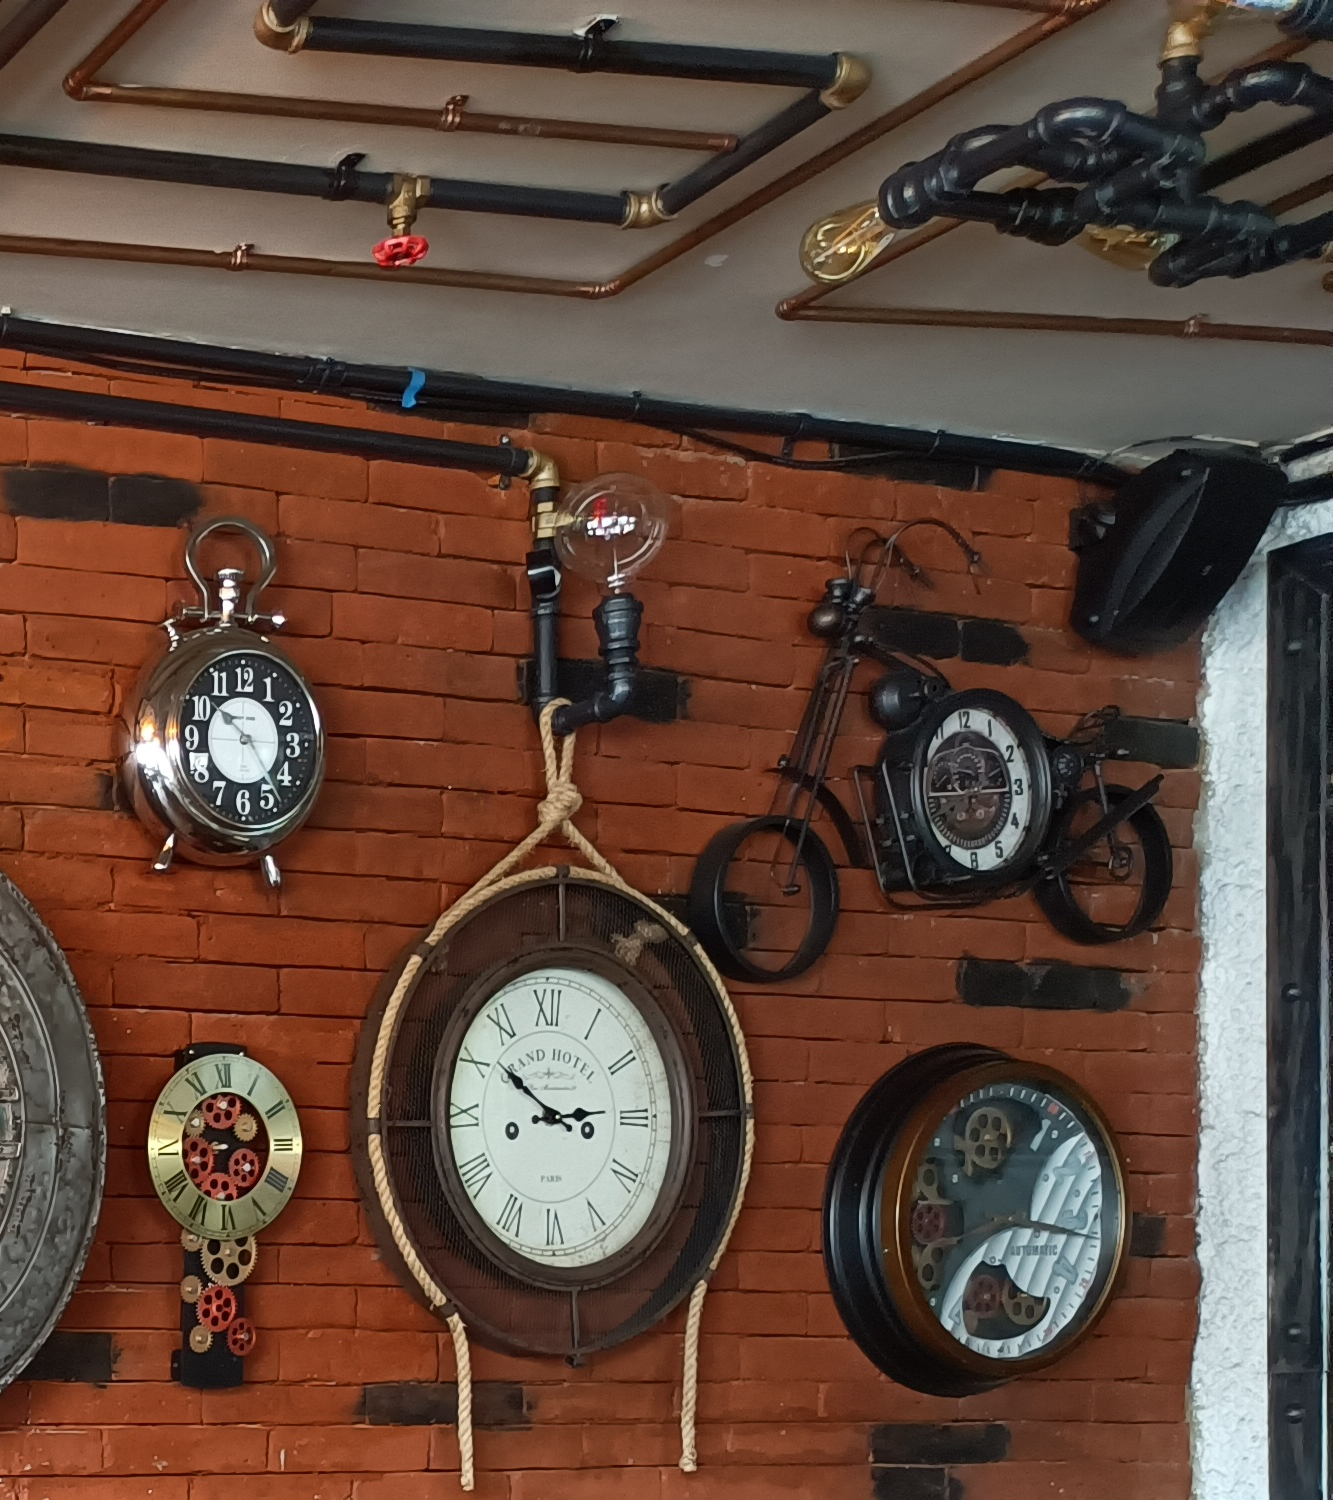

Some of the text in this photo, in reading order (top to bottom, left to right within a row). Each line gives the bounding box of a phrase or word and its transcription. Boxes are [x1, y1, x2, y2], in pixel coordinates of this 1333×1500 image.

[211, 671, 229, 697] 11
[235, 667, 254, 692] 12
[263, 677, 275, 702] 1
[192, 695, 211, 721] 10
[279, 701, 293, 726] 2
[958, 711, 971, 730] 12
[185, 725, 199, 750] 9
[987, 719, 992, 737] 1
[286, 732, 300, 757] 3
[1005, 745, 1014, 763] 2
[194, 756, 209, 783] 8
[277, 761, 292, 786] 4
[212, 780, 226, 806] 7
[260, 784, 275, 809] 5
[1013, 778, 1024, 796] 3
[236, 789, 251, 815] 6
[1010, 812, 1019, 829] 4
[994, 840, 1004, 859] 5
[533, 989, 561, 1027] XII
[486, 1003, 516, 1046] XI
[584, 1008, 601, 1040] I
[459, 1046, 490, 1078] X
[551, 1048, 595, 1084] HOTEL
[608, 1049, 636, 1075] II
[185, 1071, 207, 1098] XI
[214, 1063, 232, 1089] XII
[247, 1073, 260, 1097] I
[163, 1101, 188, 1122] X
[264, 1100, 286, 1120] II
[450, 1102, 479, 1129] IX
[620, 1108, 648, 1128] III
[273, 1138, 293, 1152] III
[459, 1152, 493, 1199] VIII
[221, 1204, 236, 1231] VI
[250, 1196, 267, 1217] V
[496, 1193, 522, 1238] VII
[585, 1197, 606, 1232] V
[546, 1208, 564, 1245] VI
[1010, 1244, 1058, 1256] AUTOMATIC
